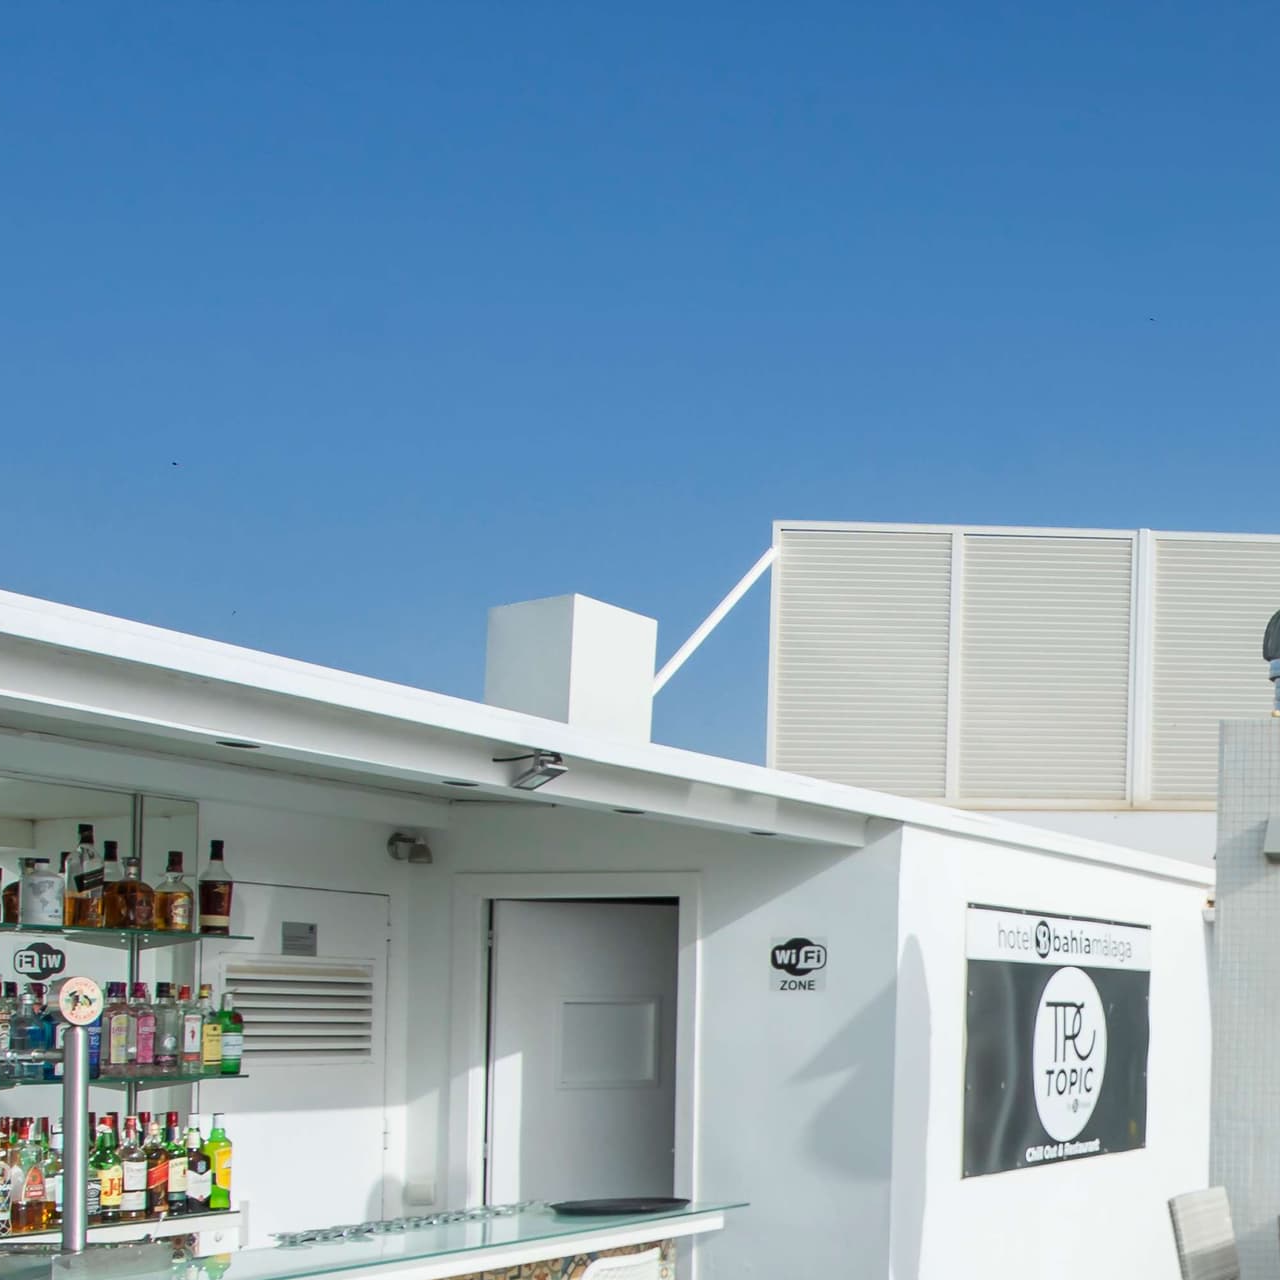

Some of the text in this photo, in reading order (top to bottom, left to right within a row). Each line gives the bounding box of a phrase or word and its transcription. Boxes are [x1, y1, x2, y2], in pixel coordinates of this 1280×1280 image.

[998, 922, 1034, 950] hotel
[780, 980, 816, 991] ZONE
[1046, 1066, 1094, 1097] TOPIC
